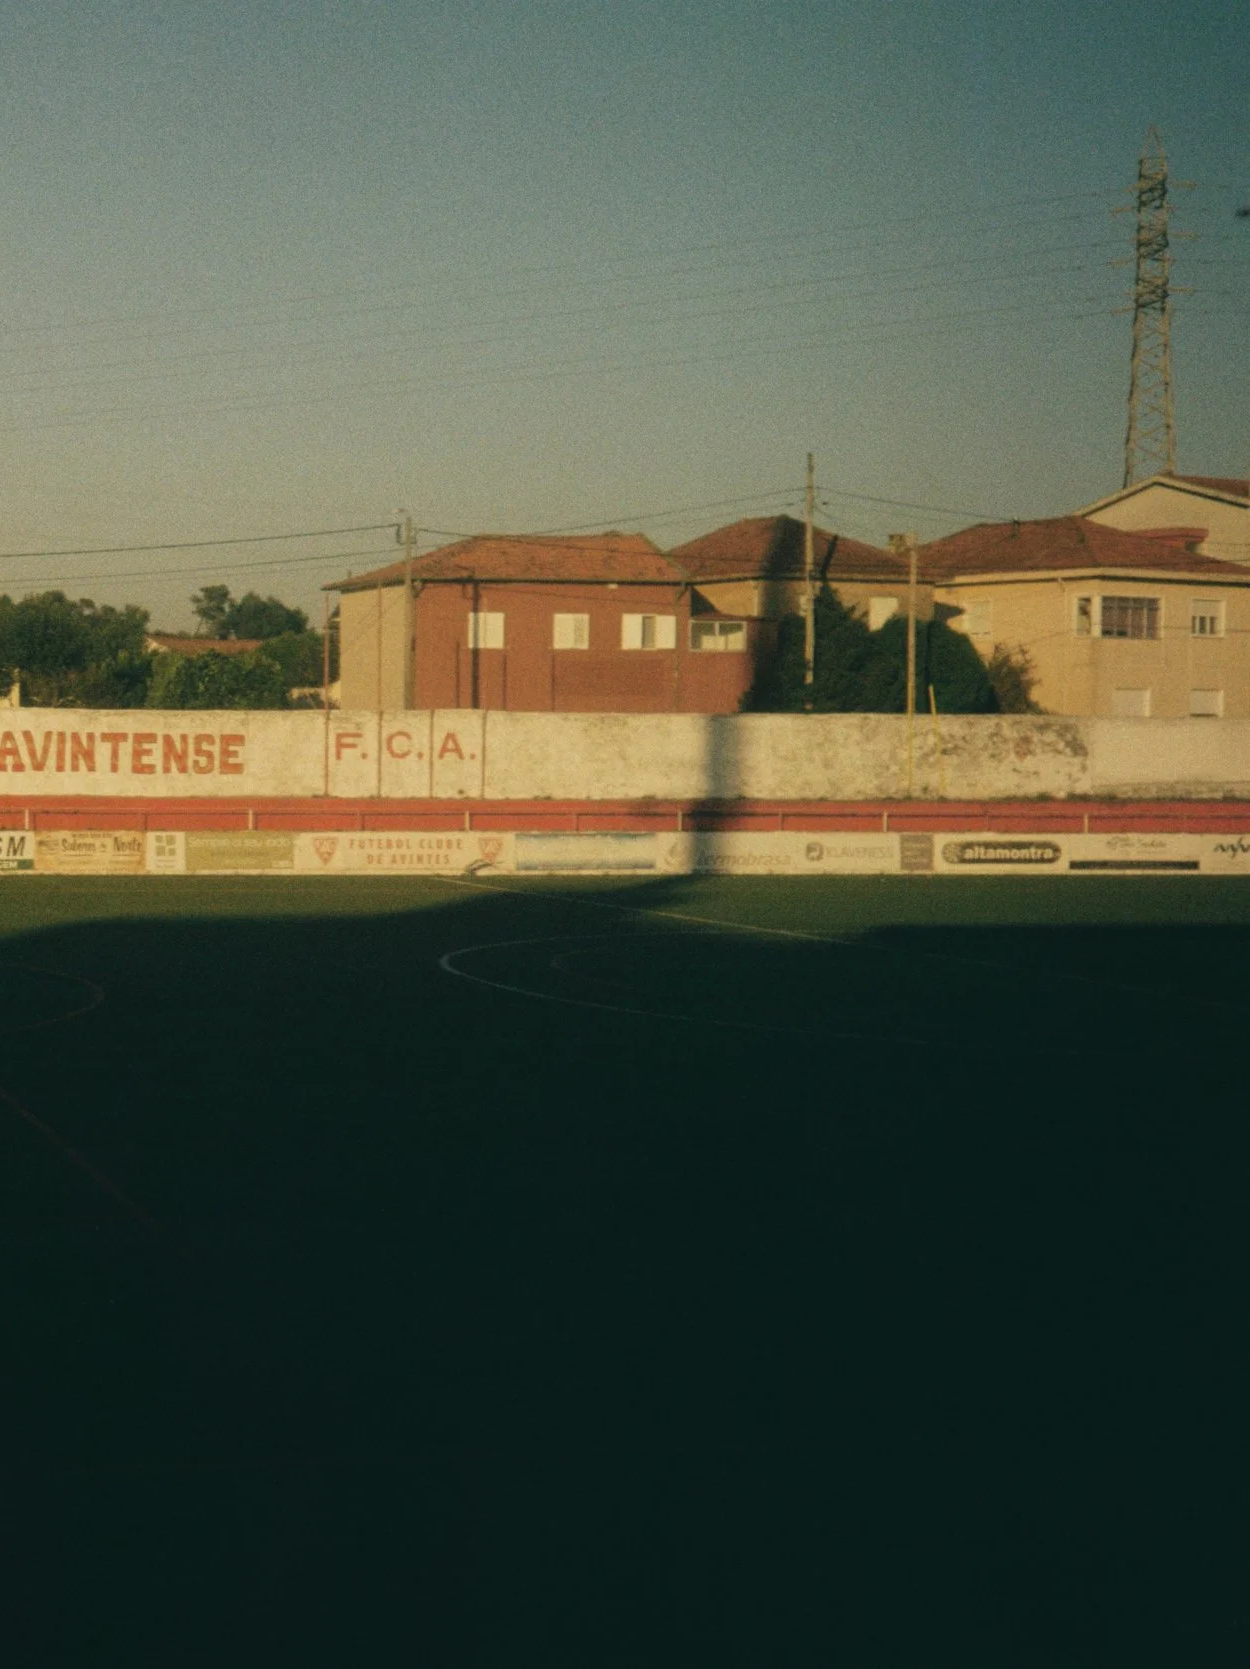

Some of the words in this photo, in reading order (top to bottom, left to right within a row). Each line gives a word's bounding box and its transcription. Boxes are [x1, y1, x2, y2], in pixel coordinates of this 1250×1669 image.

[335, 732, 369, 761] F.
[386, 730, 424, 760] C.
[438, 731, 476, 761] A.
[349, 838, 412, 850] FUTEBOL
[418, 838, 463, 850] CLUBE
[963, 845, 1054, 860] altamontra
[366, 854, 383, 865] DE
[391, 854, 451, 865] AVINTES
